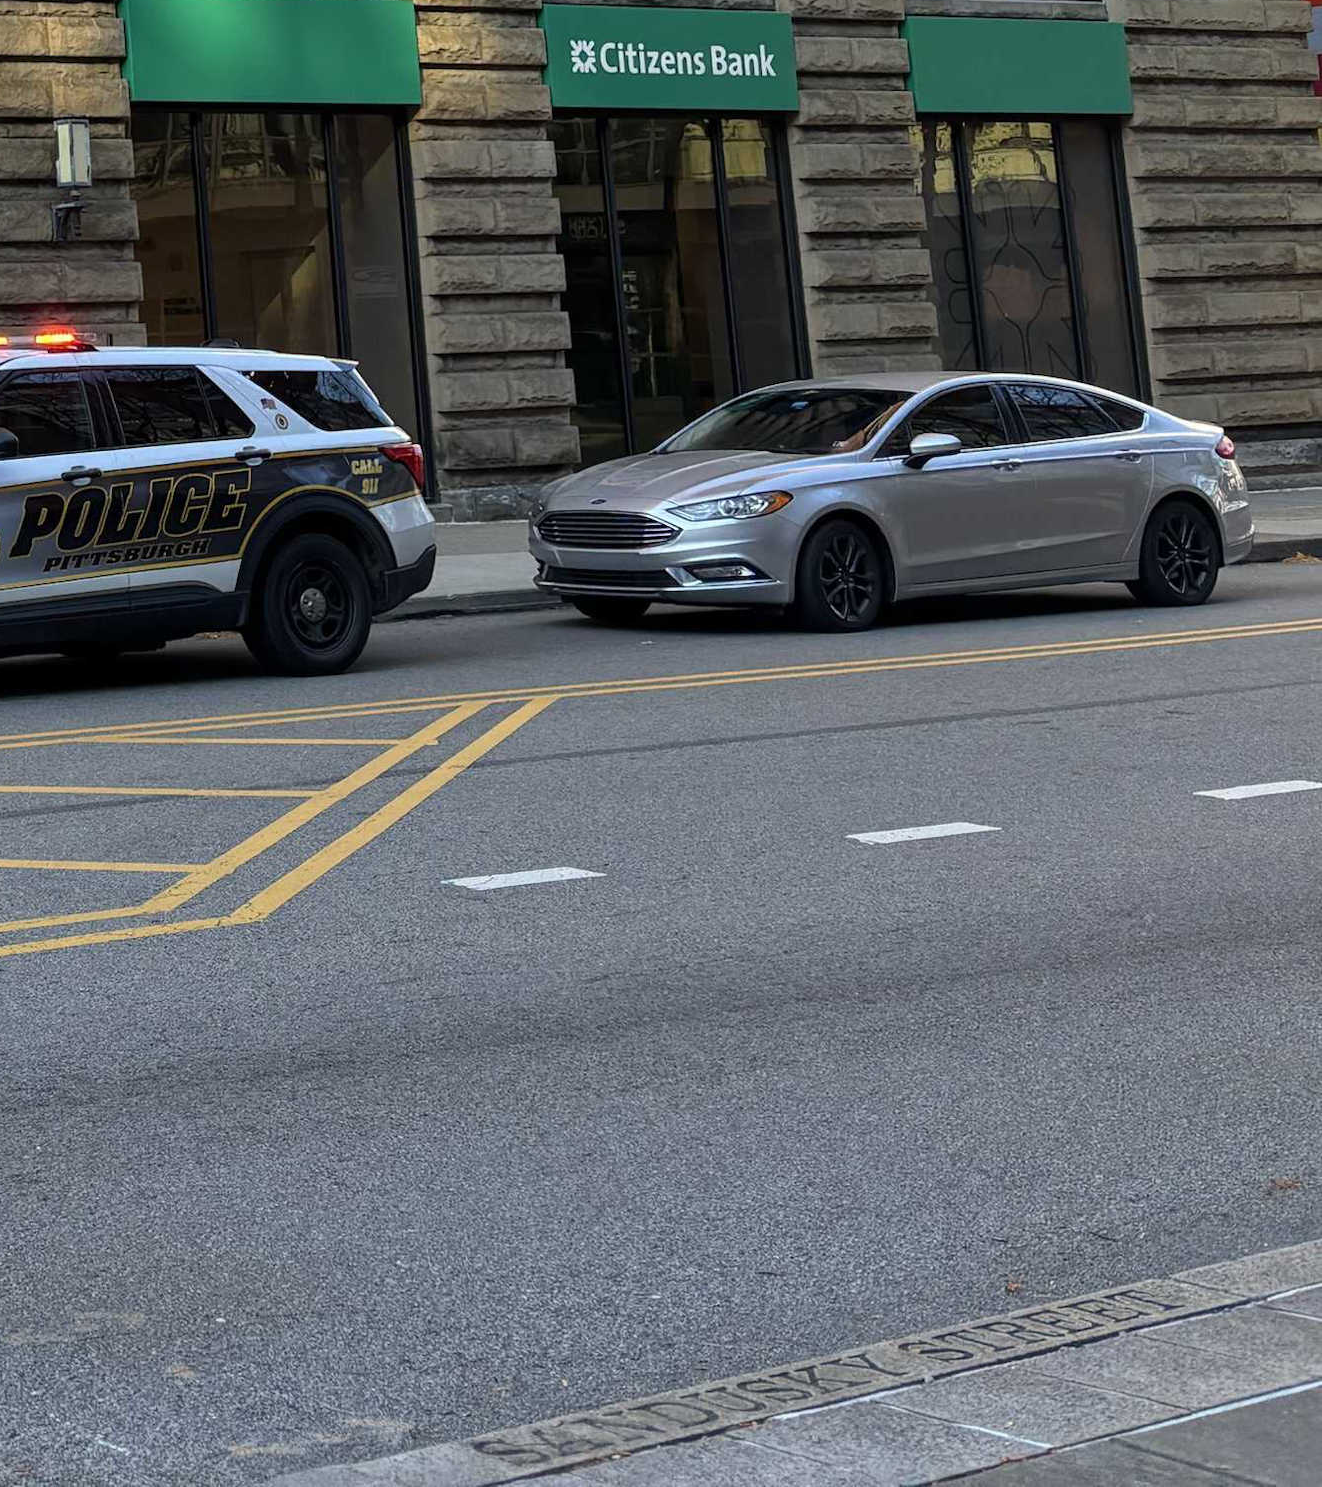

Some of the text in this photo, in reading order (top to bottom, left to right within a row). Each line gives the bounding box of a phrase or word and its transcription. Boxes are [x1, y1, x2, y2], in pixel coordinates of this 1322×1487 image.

[599, 41, 777, 77] Citizens Bank
[351, 458, 383, 475] CALL
[362, 478, 380, 494] 911
[9, 468, 252, 559] POLICE
[42, 538, 211, 573] PITTSBURGH
